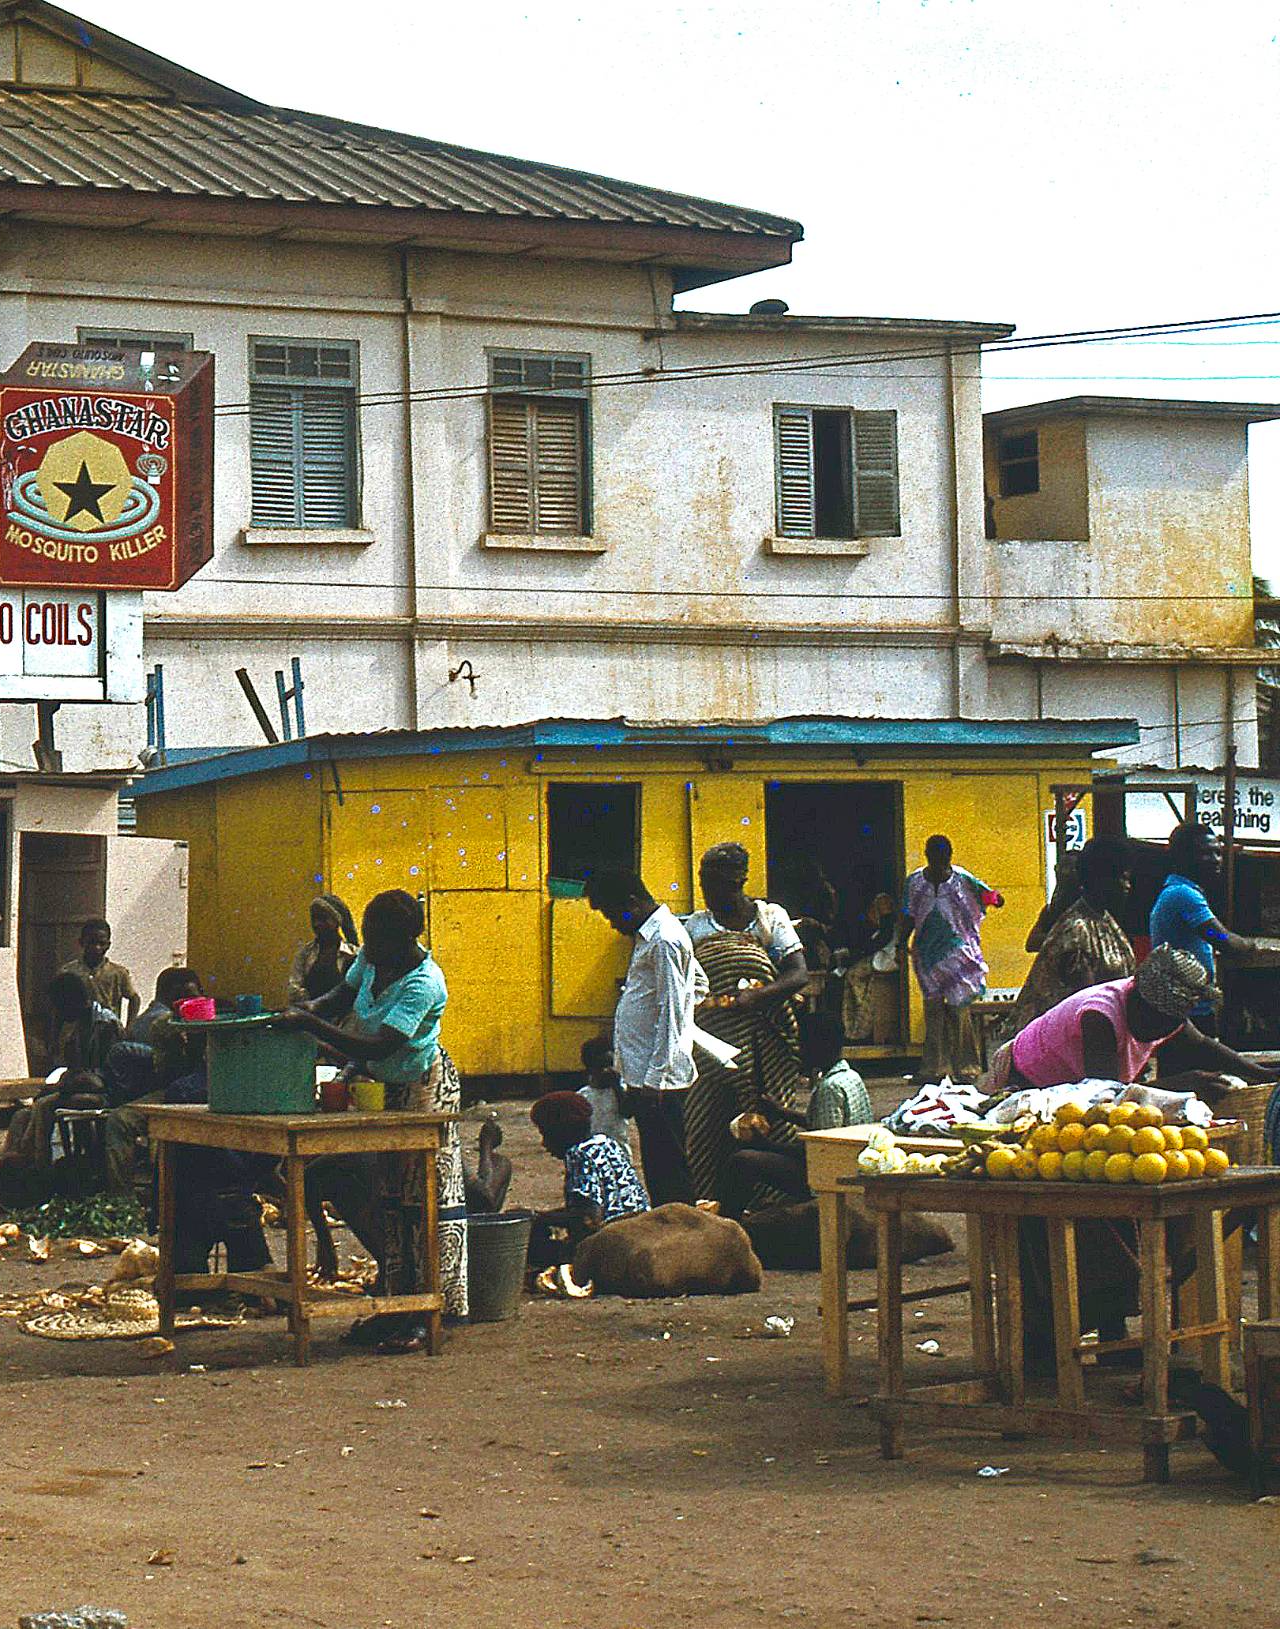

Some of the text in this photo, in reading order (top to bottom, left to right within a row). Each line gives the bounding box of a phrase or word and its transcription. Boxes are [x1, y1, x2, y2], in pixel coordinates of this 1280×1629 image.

[4, 397, 171, 450] GHANASTAR
[5, 524, 168, 564] MOSQUITO KILLER
[25, 602, 93, 646] COILS
[1249, 786, 1274, 806] the
